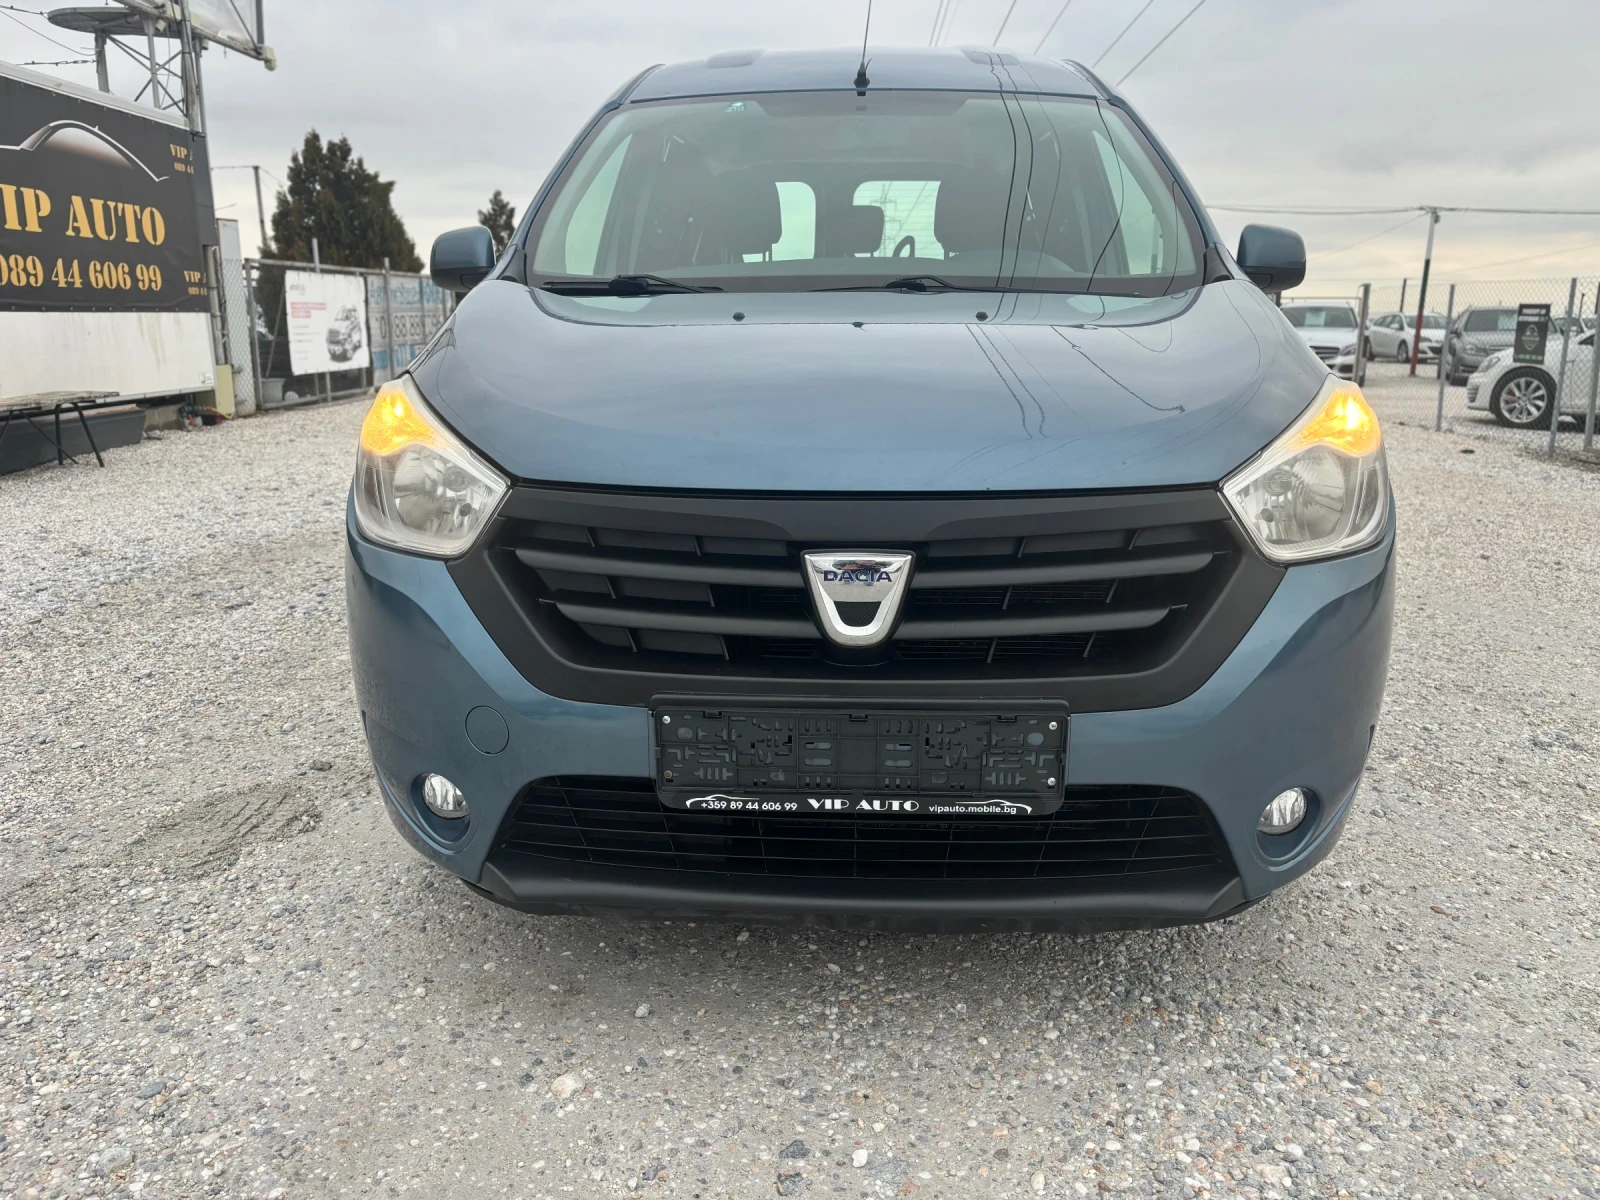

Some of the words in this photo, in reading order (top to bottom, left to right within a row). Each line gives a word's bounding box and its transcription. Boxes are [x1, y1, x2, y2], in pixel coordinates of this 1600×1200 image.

[170, 144, 187, 159] VIP
[0, 184, 51, 232] IP
[66, 195, 165, 246] AUTO
[52, 258, 83, 288] 44
[89, 260, 131, 290] 606
[136, 264, 162, 291] 99
[184, 271, 200, 282] VIP
[823, 570, 892, 583] DACIA
[701, 801, 727, 810] +359
[730, 801, 743, 810] 89
[746, 801, 759, 810] 44
[762, 802, 782, 811] 606
[784, 802, 798, 811] 99
[807, 799, 850, 810] VIP
[856, 799, 919, 811] AUTO
[929, 803, 1017, 815] vipauto.mobile.bg
